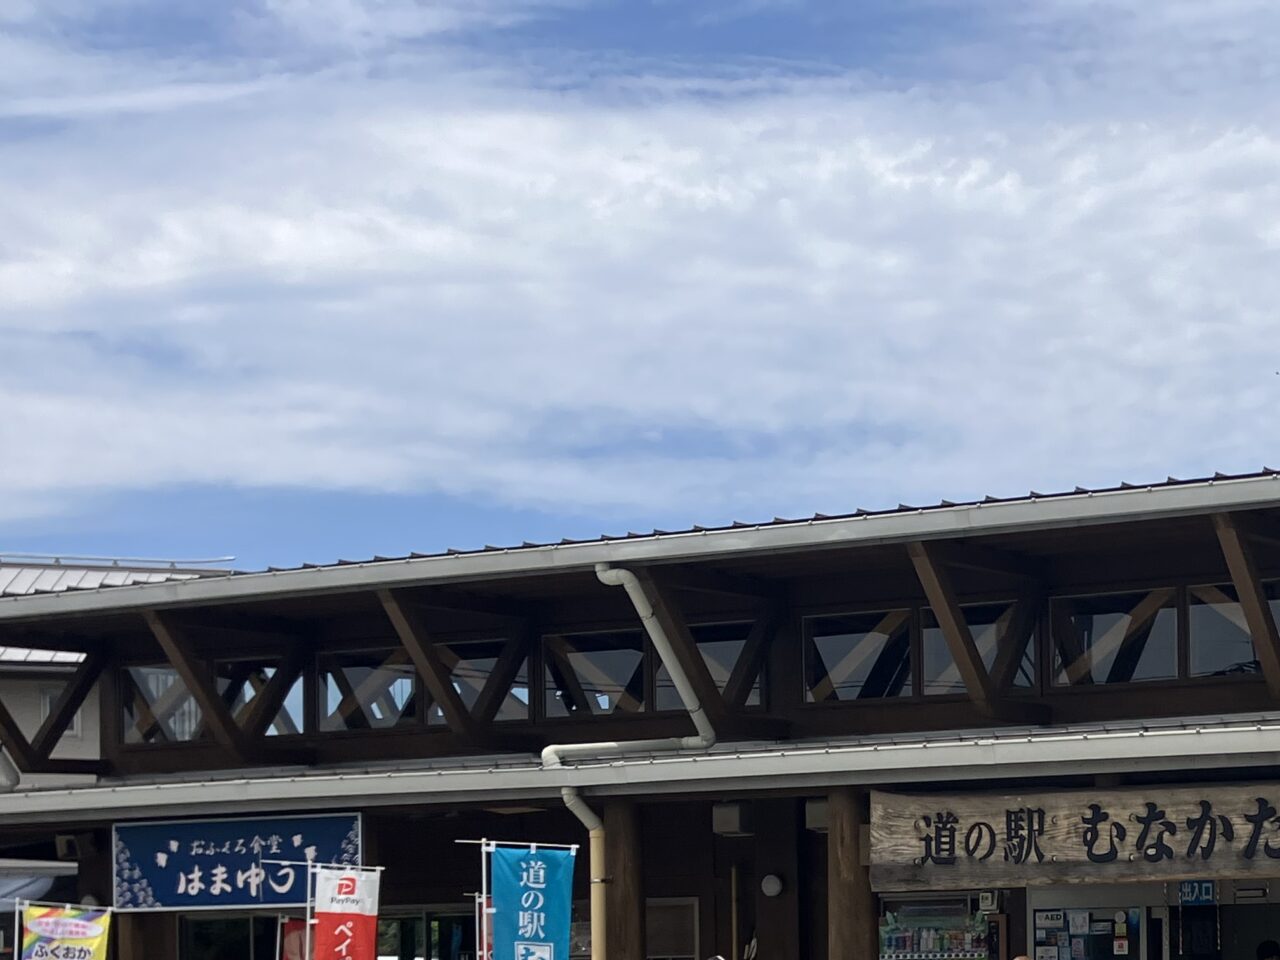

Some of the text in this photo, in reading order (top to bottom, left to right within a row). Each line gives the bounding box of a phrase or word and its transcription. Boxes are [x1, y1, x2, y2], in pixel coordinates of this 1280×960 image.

[189, 834, 283, 856] おふくろ食堂
[919, 807, 1046, 866] 道の駅
[177, 861, 296, 898] はまゆう
[330, 896, 360, 906] PayPay
[517, 860, 548, 940] 道の駅
[1181, 882, 1214, 901] 出入口
[1044, 913, 1062, 921] AED
[34, 944, 91, 960] ふくおか
